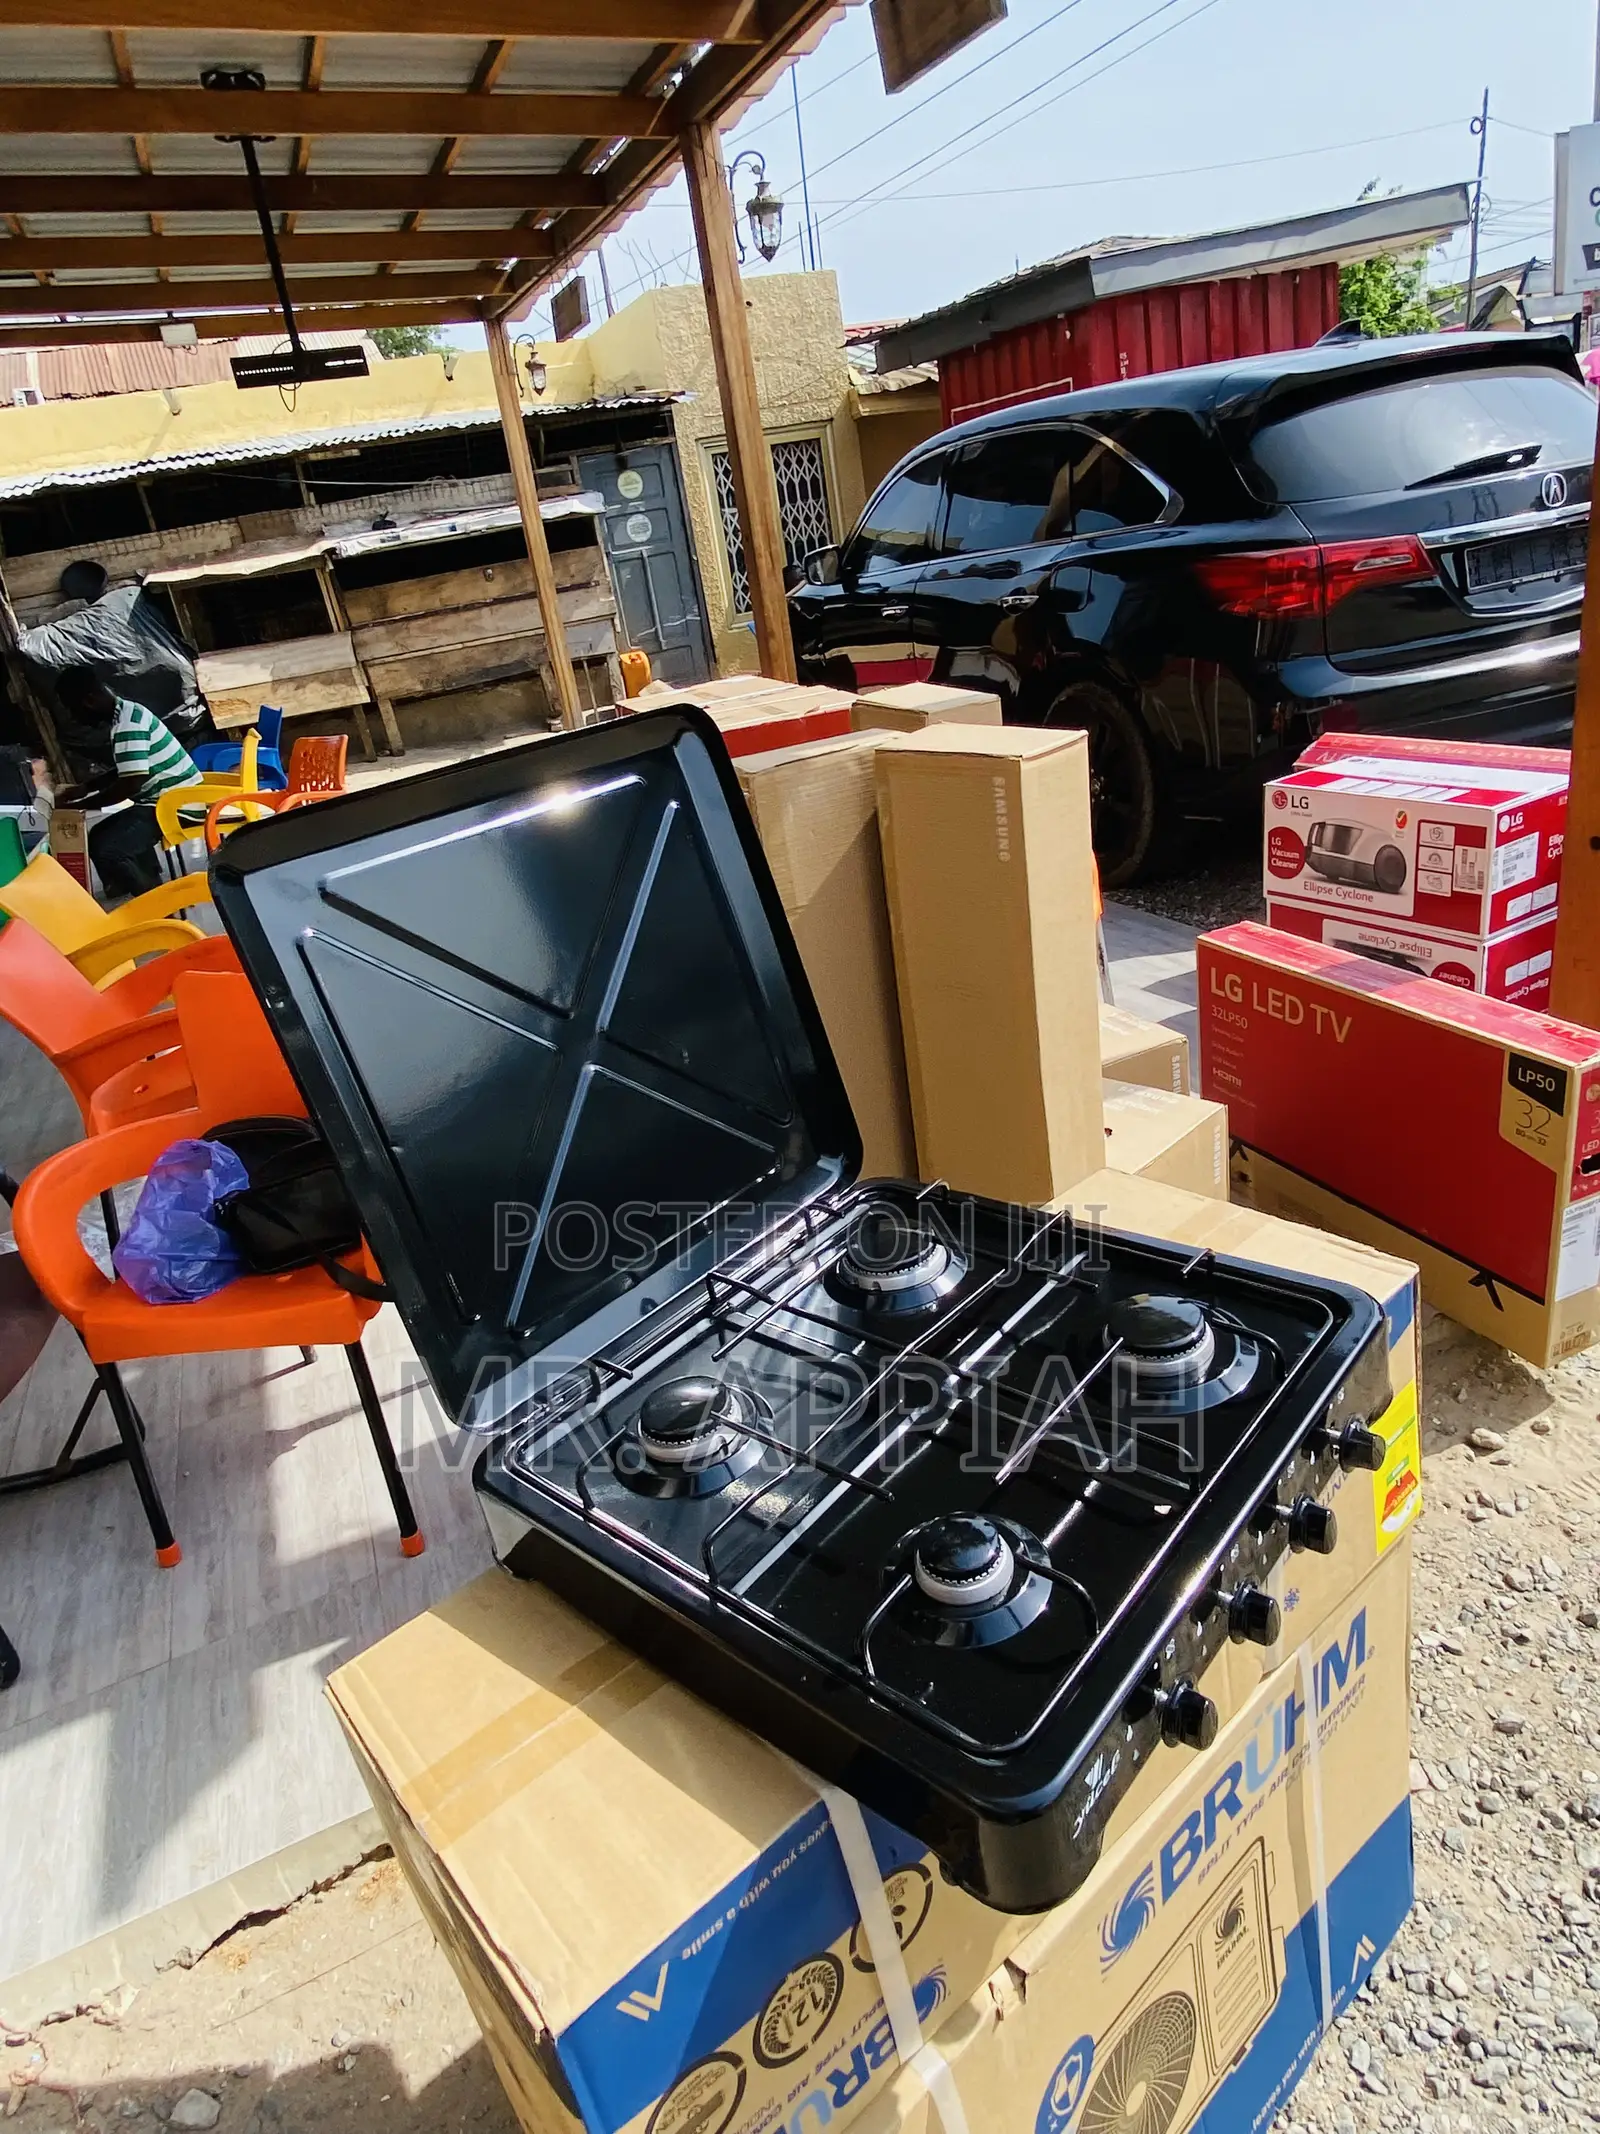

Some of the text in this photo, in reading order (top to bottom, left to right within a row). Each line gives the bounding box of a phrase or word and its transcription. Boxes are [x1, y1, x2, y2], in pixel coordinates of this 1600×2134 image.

[1291, 795, 1309, 810] LG
[992, 776, 1011, 862] SAMSUNG
[1511, 812, 1524, 826] LG
[1271, 837, 1282, 846] LG
[1271, 847, 1300, 859] Vacuum
[1547, 845, 1563, 859] Cycl
[1548, 834, 1564, 848] Ellip
[1271, 859, 1299, 870] Cleaner
[1303, 881, 1374, 903] Ellipse Cyclone
[1358, 932, 1433, 958] Ellipse Cyclone
[1438, 971, 1471, 987] Cleaner
[1210, 967, 1243, 1003] LG
[1252, 982, 1304, 1025] LED
[1310, 1003, 1352, 1043] TV
[1211, 1005, 1248, 1030] 32LP50
[1172, 1055, 1181, 1094] SAMSU
[1518, 1067, 1555, 1092] LP50
[1515, 1098, 1551, 1138] 32
[1198, 1834, 1232, 1884] SPLIT
[1236, 1796, 1265, 1836] TYPE
[1268, 1766, 1288, 1798] AIR
[770, 1848, 797, 1879] you
[739, 1877, 770, 1908] with
[726, 1907, 737, 1920] a
[682, 1916, 724, 1960] smile
[815, 2036, 846, 2075] TYPE
[787, 2074, 810, 2104] AIR
